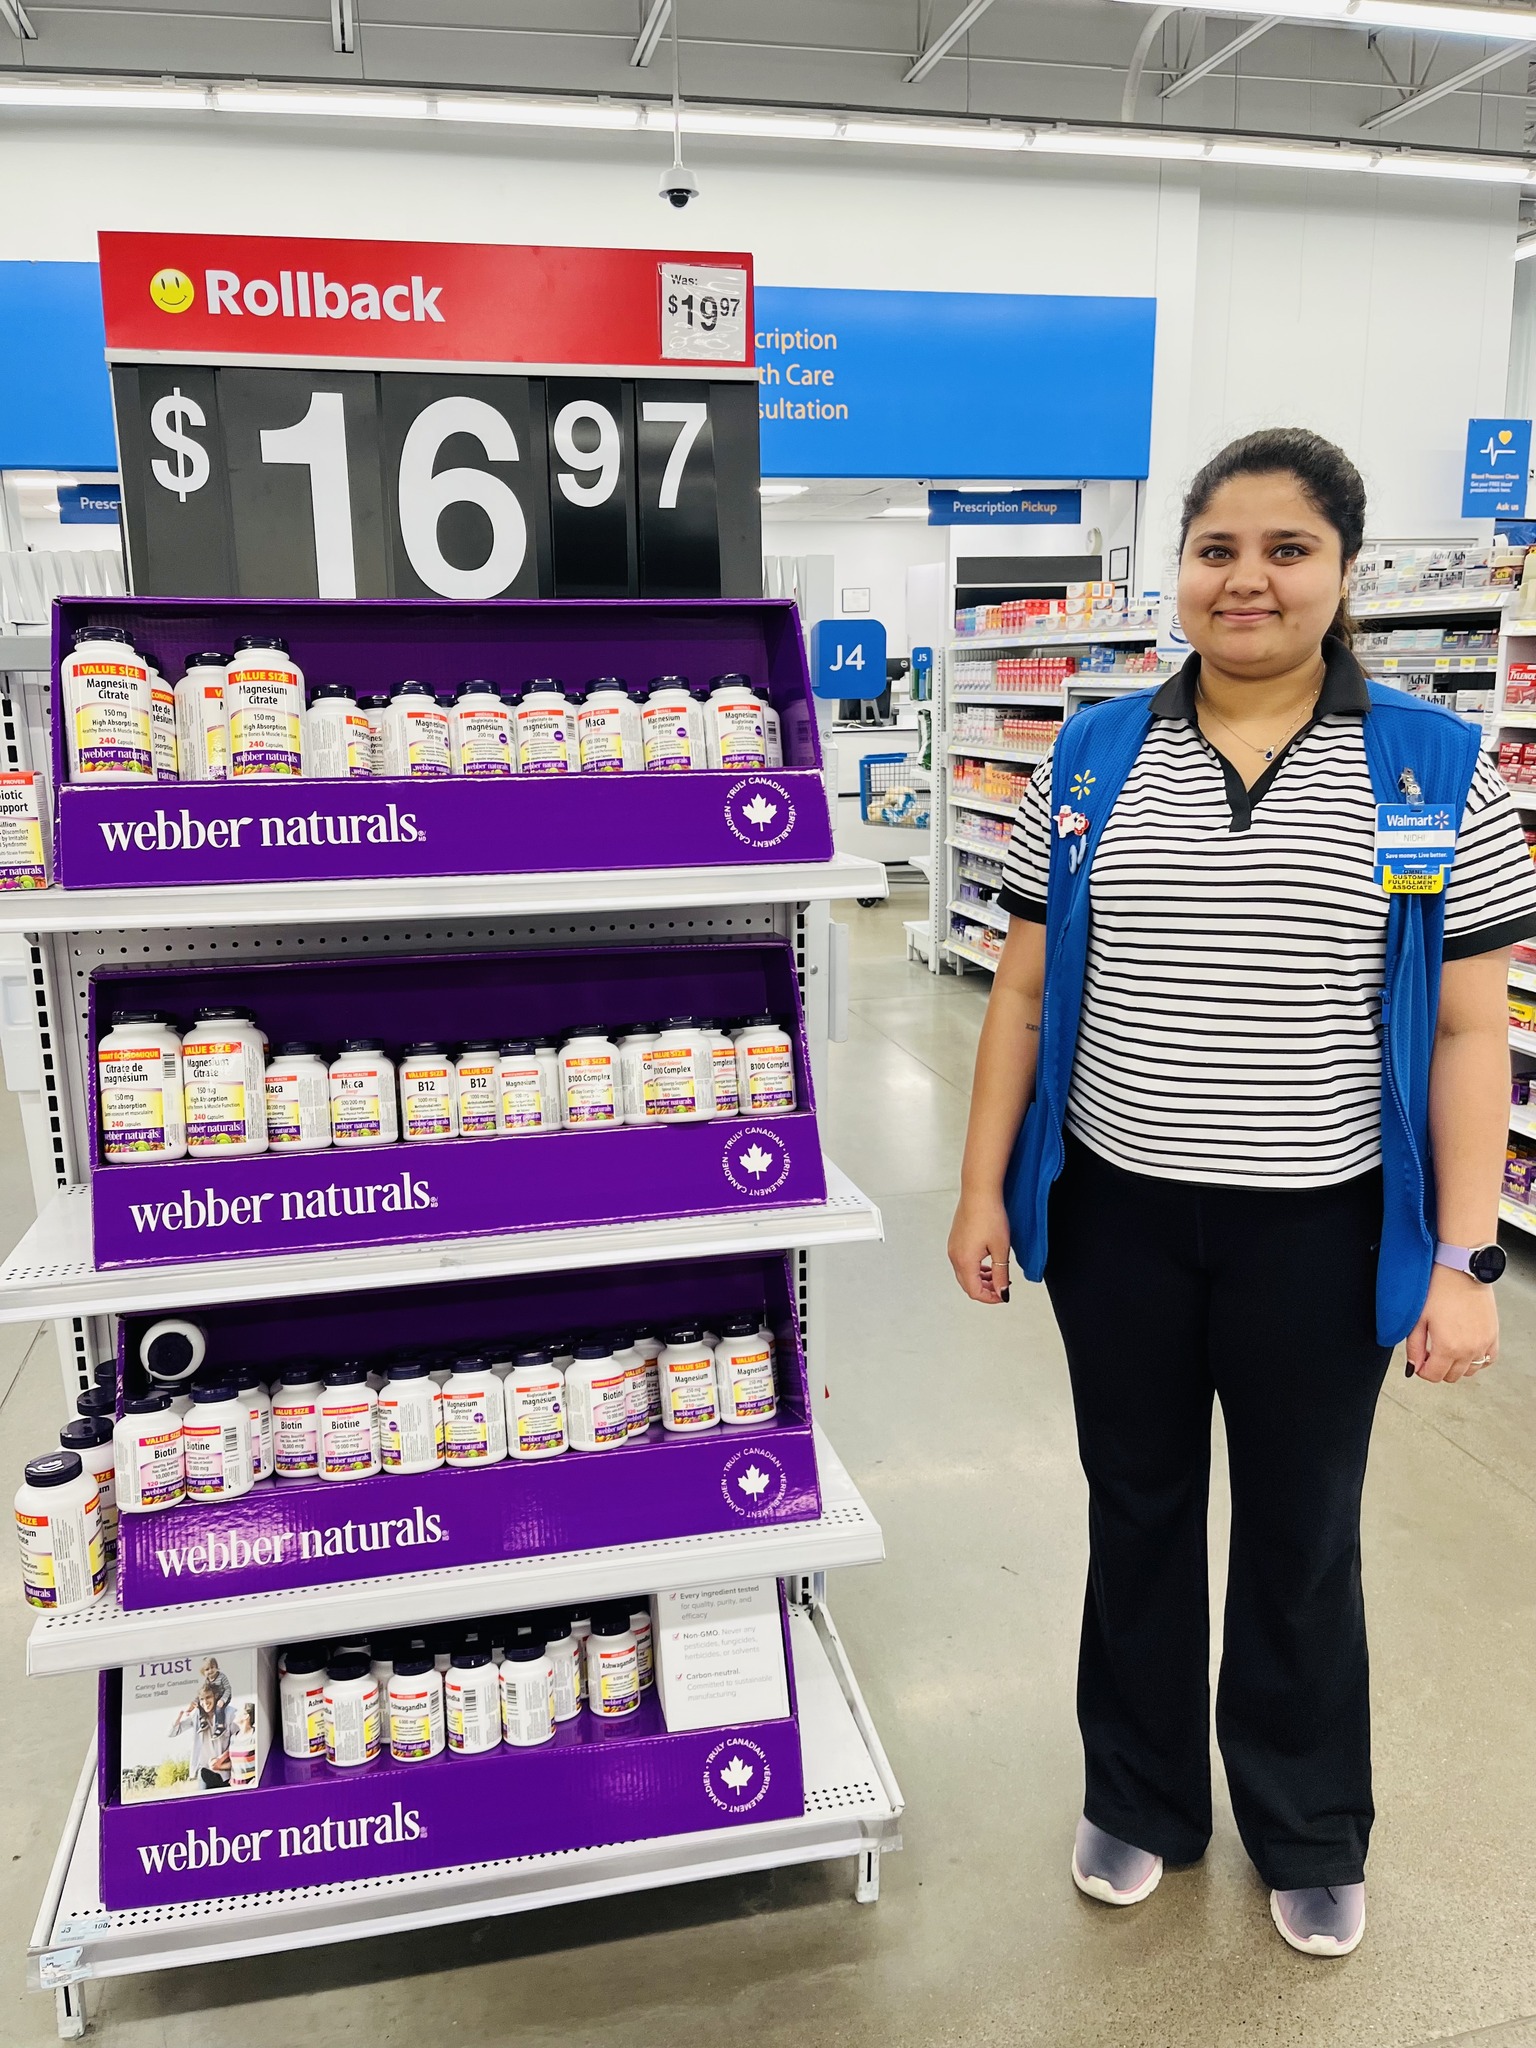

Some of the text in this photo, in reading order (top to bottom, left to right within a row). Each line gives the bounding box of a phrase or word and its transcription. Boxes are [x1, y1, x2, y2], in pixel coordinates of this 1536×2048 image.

[671, 274, 698, 286] Was:
[205, 269, 444, 323] Rollback
[754, 328, 837, 355] cription
[786, 363, 834, 385] Care
[758, 397, 848, 420] sultation
[953, 499, 1057, 515] Prescription Pickup
[829, 643, 866, 672] J4
[917, 653, 927, 662] J5
[82, 665, 140, 677] VALUE SIZE
[235, 671, 289, 682] VALUE SIZE
[86, 678, 138, 691] Magnesium
[1409, 674, 1430, 685] Advil
[98, 689, 129, 700] Citrate
[239, 684, 287, 695] Magnesium
[248, 695, 278, 705] Citrate
[104, 709, 127, 719] 150 mg
[253, 713, 276, 722] 150 mg
[647, 714, 681, 725] Magnesium
[725, 711, 758, 721] Magnesium
[92, 719, 139, 728] High Absorption
[256, 723, 287, 731] Absorption
[415, 719, 446, 730] Magnesium
[466, 723, 504, 732] magnésium
[523, 721, 559, 732] magnésium
[585, 716, 606, 728] Maca
[99, 736, 116, 745] 240
[248, 740, 264, 748] 240
[726, 776, 790, 800] TRULY CANADIAN
[1387, 814, 1432, 826] Walmart
[98, 808, 254, 852] webber
[724, 804, 797, 848] VÉRITABLEMENT CANADIEN
[1403, 834, 1425, 842] NIDHI
[209, 1044, 231, 1053] SIZE
[752, 1046, 773, 1055] VALUE
[105, 1062, 143, 1074] Citrate de
[664, 1065, 691, 1075] Complex
[750, 1060, 790, 1071] B100 Complex
[104, 1072, 148, 1085] magnésium
[408, 1071, 429, 1079] VALUE
[568, 1073, 611, 1083] B100 Complex
[265, 1083, 283, 1093] Maca
[418, 1080, 435, 1092] B12
[470, 1077, 487, 1088] B12
[505, 1080, 537, 1088] Magnesium
[118, 1102, 147, 1110] absorption
[193, 1113, 206, 1121] 240
[112, 1120, 124, 1128] 240
[723, 1126, 785, 1150] TRULY CANADIAN
[721, 1152, 792, 1197] VÉRITABLEMENT CANADIEN
[1508, 1163, 1526, 1175] Advil
[128, 1186, 275, 1234] webber
[674, 1361, 708, 1372] VALUE SIZE
[737, 1365, 769, 1376] Magnesium
[674, 1373, 709, 1384] Magnesium
[522, 1395, 557, 1406] magnésium
[602, 1390, 624, 1402] Biotine
[446, 1400, 478, 1409] Magnesium
[275, 1407, 310, 1416] VALUE SIZE
[280, 1420, 303, 1430] Biotin
[331, 1419, 360, 1430] Biotine
[145, 1434, 170, 1445] VALUE
[187, 1441, 210, 1451] Biotine
[154, 1446, 177, 1460] Biotin
[723, 1447, 782, 1472] TRULY CANADIAN
[721, 1479, 745, 1516] CANADIEN
[21, 1516, 38, 1526] SIZE
[156, 1530, 294, 1579] webber
[701, 1589, 737, 1599] ingredient
[737, 1585, 760, 1593] tested
[681, 1602, 690, 1610] for
[691, 1600, 716, 1610] quality,
[717, 1598, 738, 1607] purity,
[682, 1612, 708, 1621] efficacy
[743, 1626, 756, 1634] any
[602, 1656, 636, 1670] Ashwagandha
[686, 1668, 741, 1680] Carbon-neutral.
[135, 1683, 156, 1691] Caring
[167, 1679, 199, 1688] Canadians
[706, 1738, 765, 1764] TRULY CANADIAN
[703, 1764, 772, 1813] VÉRITABLEMENT CANADIEN
[137, 1826, 273, 1876] webber
